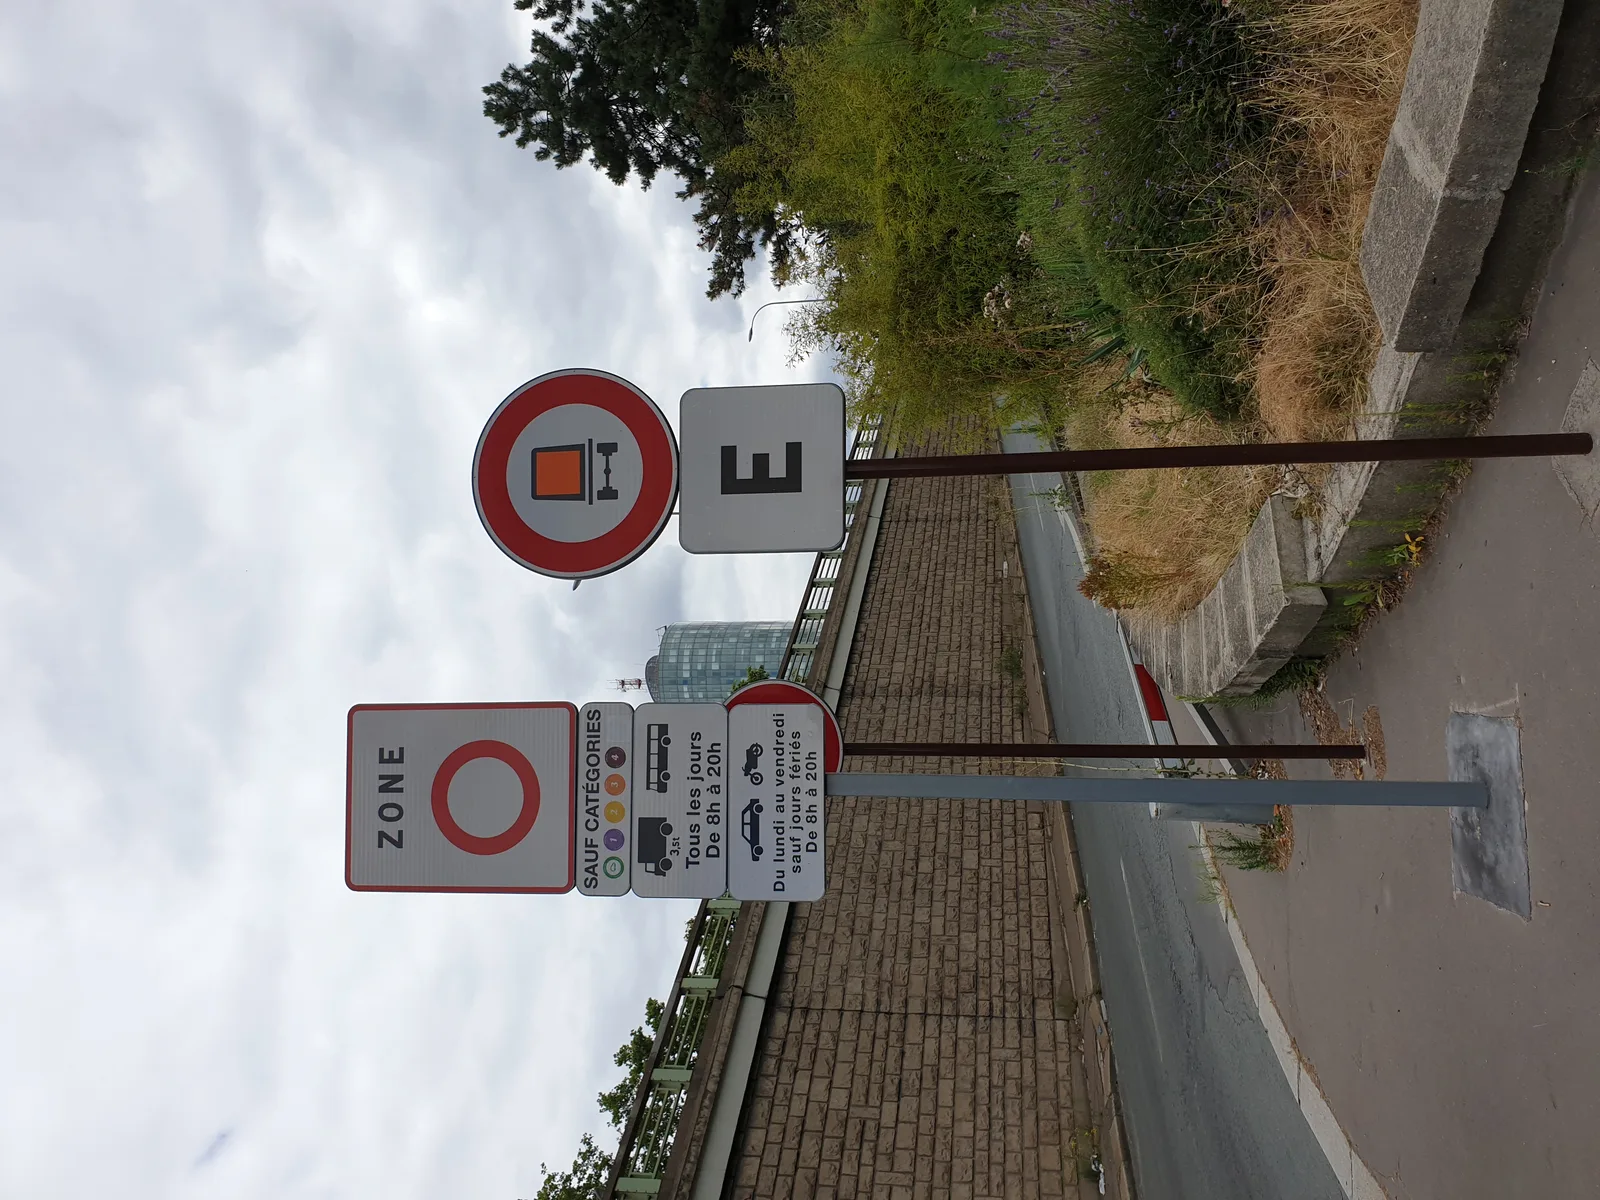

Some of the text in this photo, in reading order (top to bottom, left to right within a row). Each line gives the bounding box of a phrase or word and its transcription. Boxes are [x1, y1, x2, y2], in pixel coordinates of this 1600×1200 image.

[721, 442, 802, 495] E
[378, 747, 404, 848] ZONE
[582, 710, 601, 889] SAUF CATÉGORIES
[686, 732, 704, 869] Tous les jours
[706, 742, 721, 858] De 8h à 20h
[773, 713, 785, 891] Du lundi au vendredi
[789, 731, 804, 873] sauf jours fériés
[806, 752, 817, 781] 20h
[806, 804, 817, 823] 8h
[670, 837, 680, 856] 3,5t
[806, 831, 817, 852] De
